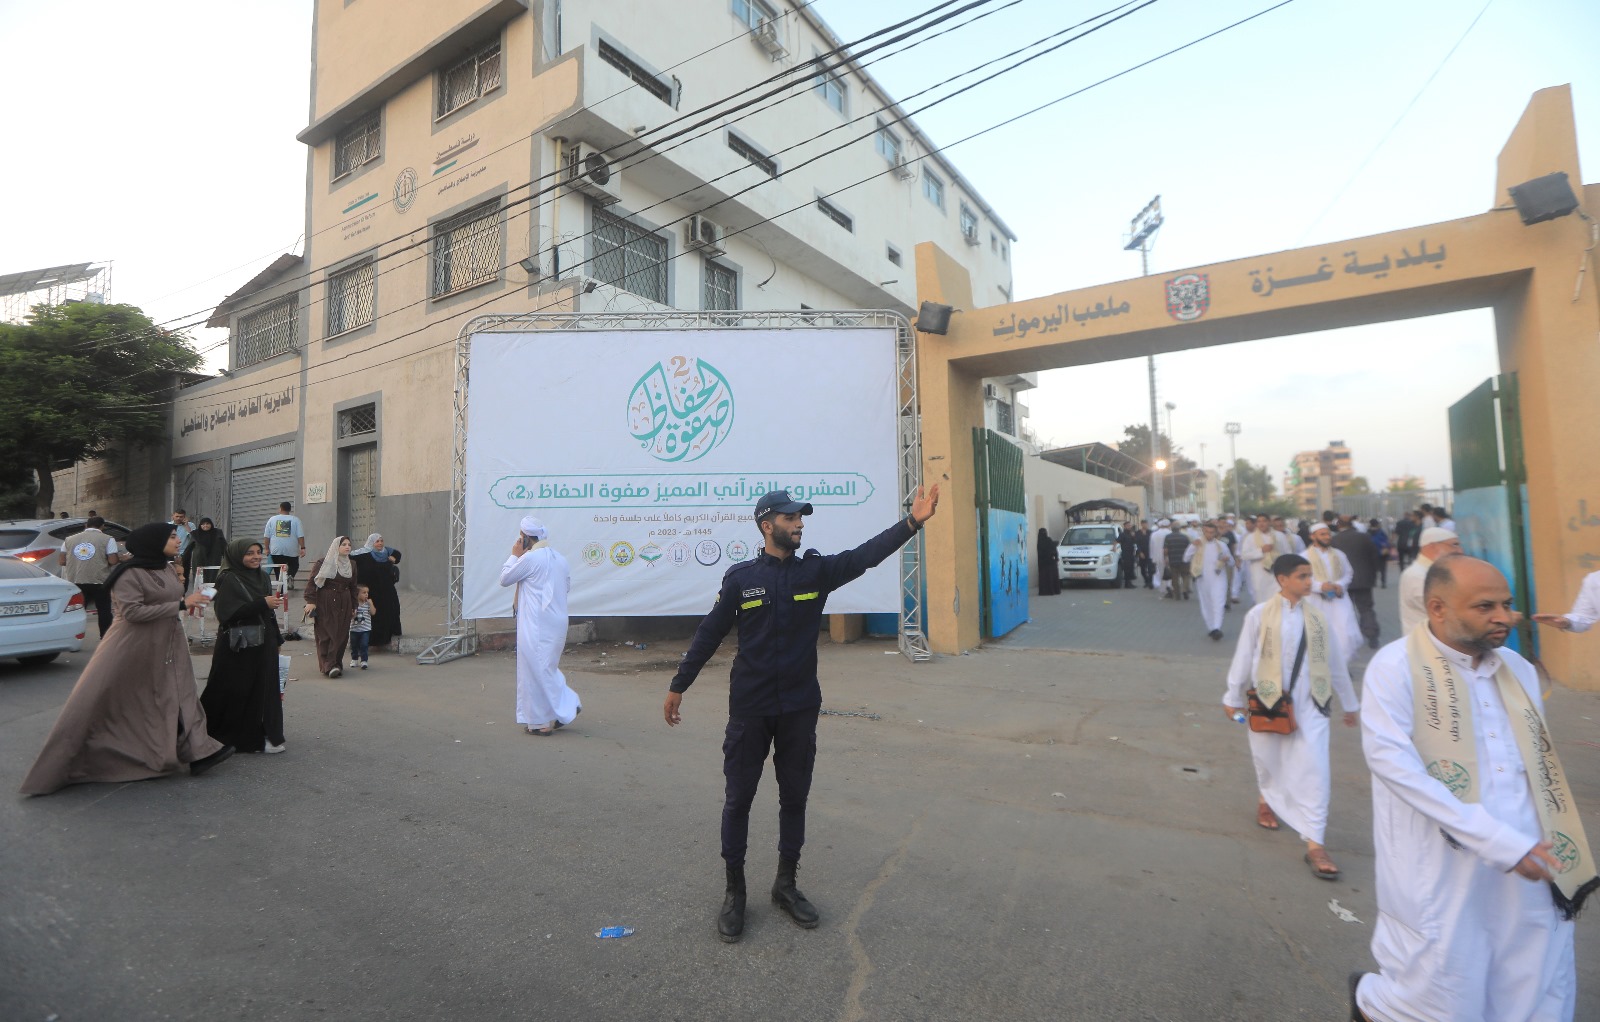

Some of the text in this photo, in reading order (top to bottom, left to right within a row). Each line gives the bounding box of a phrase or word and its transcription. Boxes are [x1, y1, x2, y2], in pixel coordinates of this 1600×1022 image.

[1343, 239, 1446, 279] بلدية
[992, 295, 1131, 341] ملعب اليرموك
[670, 355, 691, 379] 2
[180, 385, 294, 438] المديرية العامة للإصلاح والتأهيل
[537, 483, 594, 499] الحفاظ
[598, 483, 650, 503] صفوة
[653, 481, 708, 503] المميز
[593, 514, 618, 524] واحدة
[619, 514, 642, 524] جلسة
[643, 514, 662, 522] على
[683, 513, 709, 524] الكريم
[710, 511, 736, 524] القرآن
[657, 528, 677, 536] 2023
[694, 528, 712, 536] 1445
